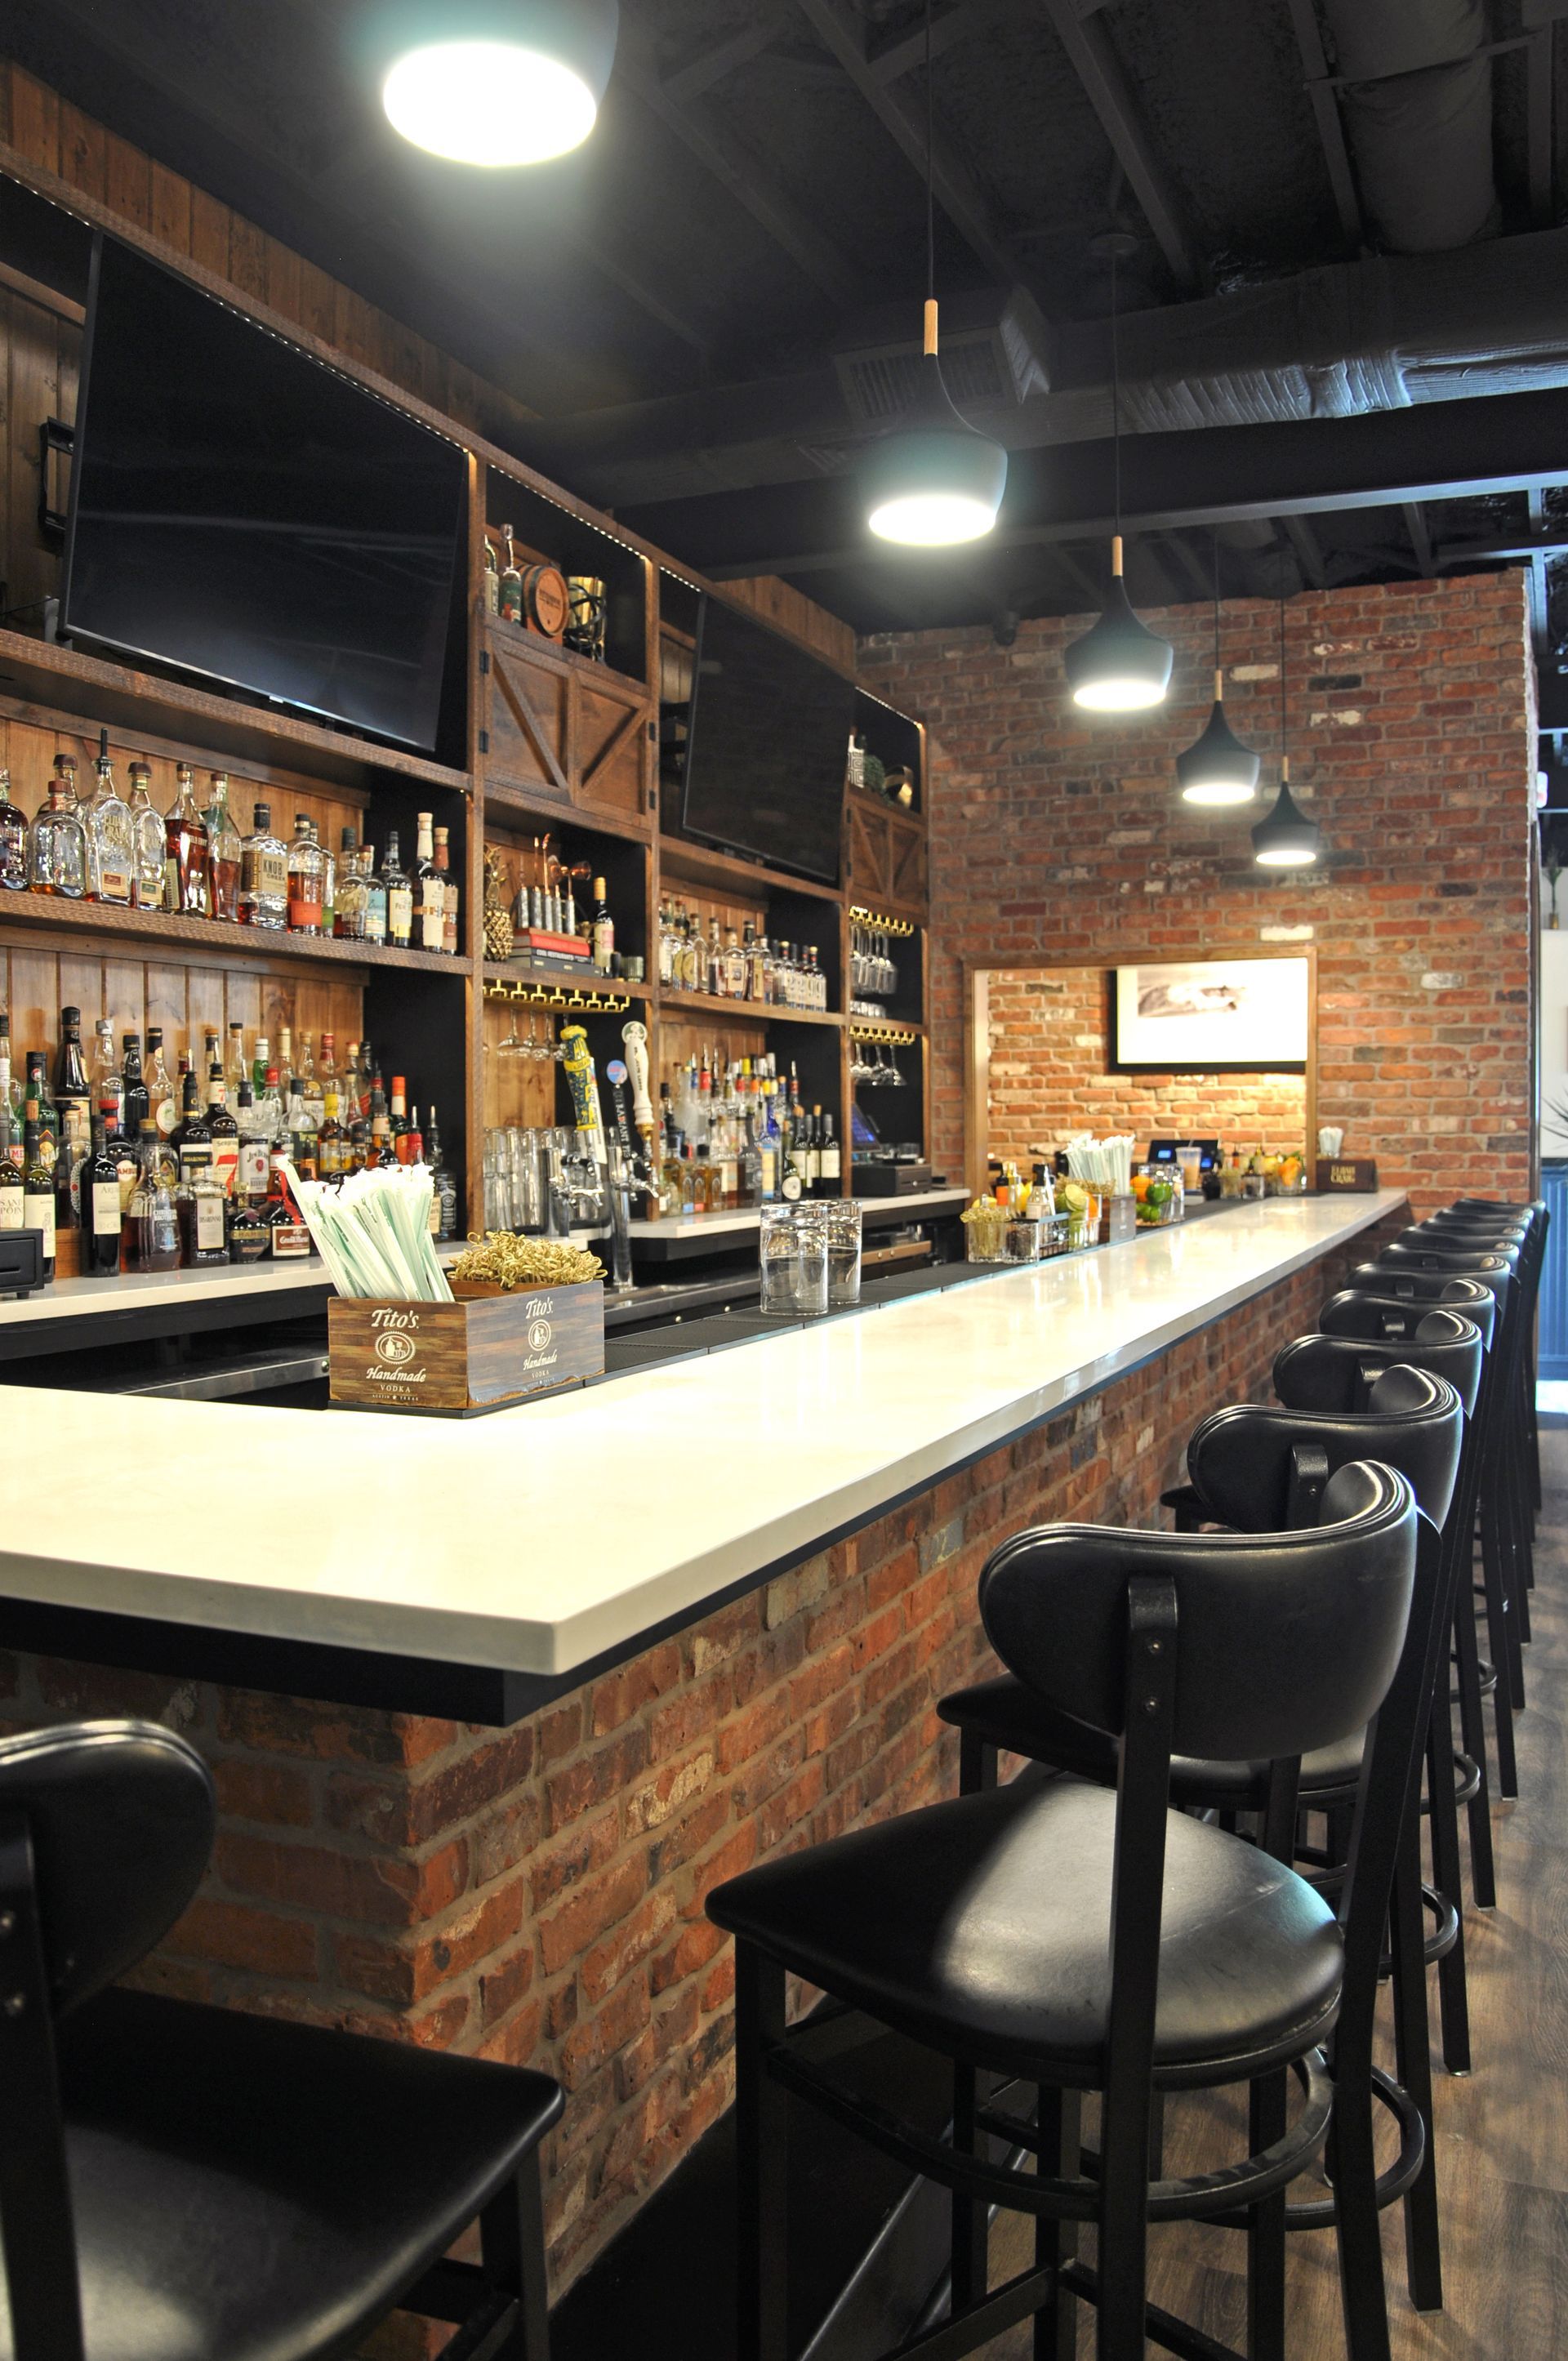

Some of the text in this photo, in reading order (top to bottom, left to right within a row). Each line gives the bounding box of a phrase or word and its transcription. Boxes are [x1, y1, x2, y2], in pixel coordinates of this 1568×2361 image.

[263, 859, 283, 875] KNOB
[266, 873, 286, 882] CREEK
[614, 1104, 630, 1143] RADIANT
[1330, 1174, 1356, 1184] CRAIG
[525, 1296, 554, 1319] Tito's
[371, 1307, 419, 1330] Tito's
[523, 1348, 558, 1371] Handmade
[366, 1365, 426, 1383] Handmade
[532, 1370, 550, 1379] VODKA
[380, 1384, 411, 1393] VODKA
